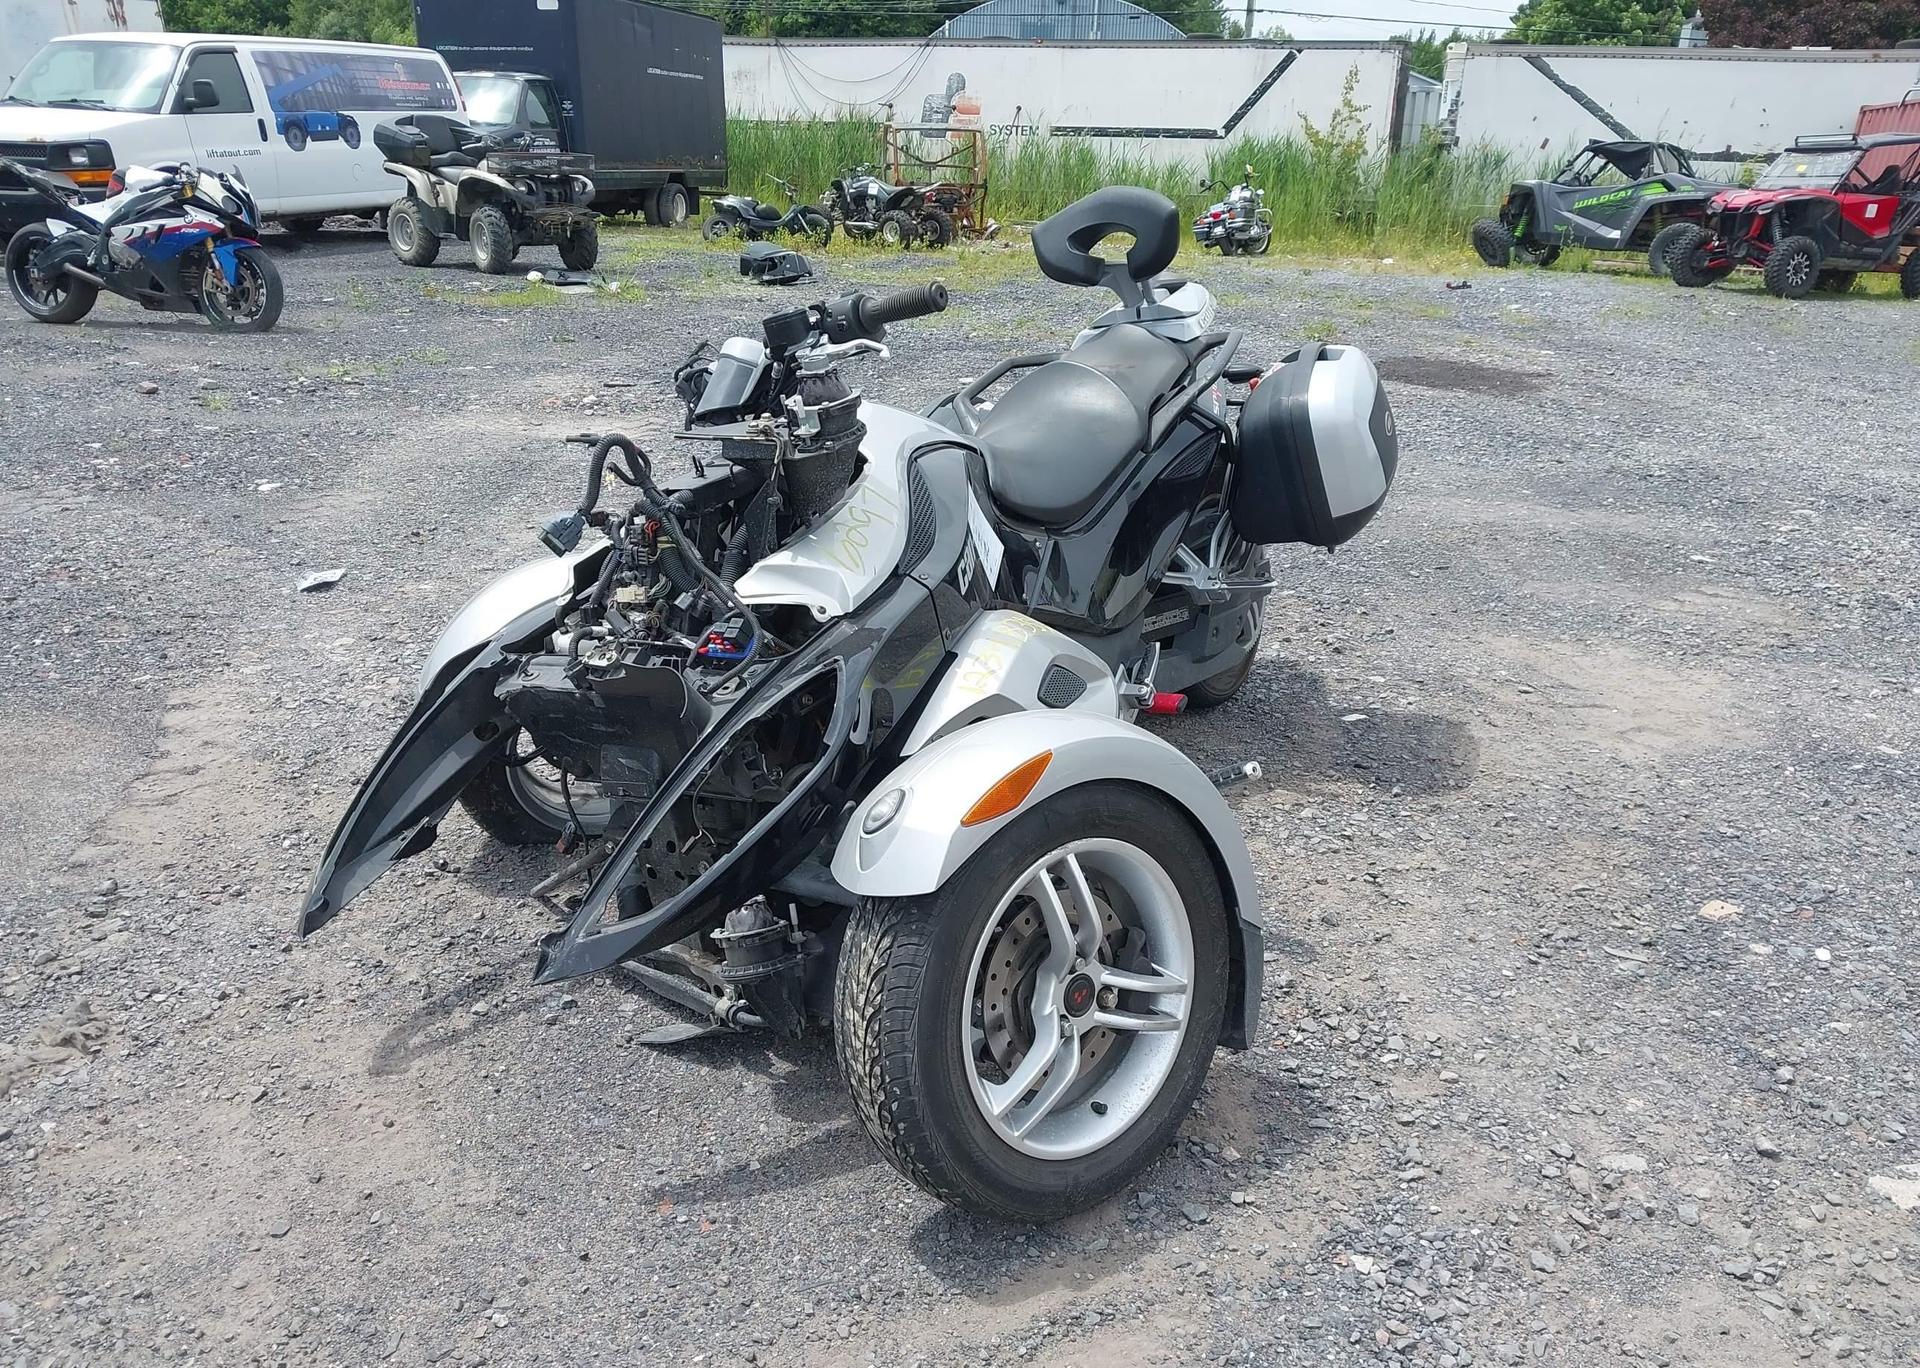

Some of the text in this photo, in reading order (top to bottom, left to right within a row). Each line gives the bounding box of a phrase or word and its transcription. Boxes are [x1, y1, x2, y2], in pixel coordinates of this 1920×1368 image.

[989, 124, 1040, 137] SYSTEM
[205, 148, 262, 159] liftatout.com
[1573, 188, 1635, 210] WILDCAT
